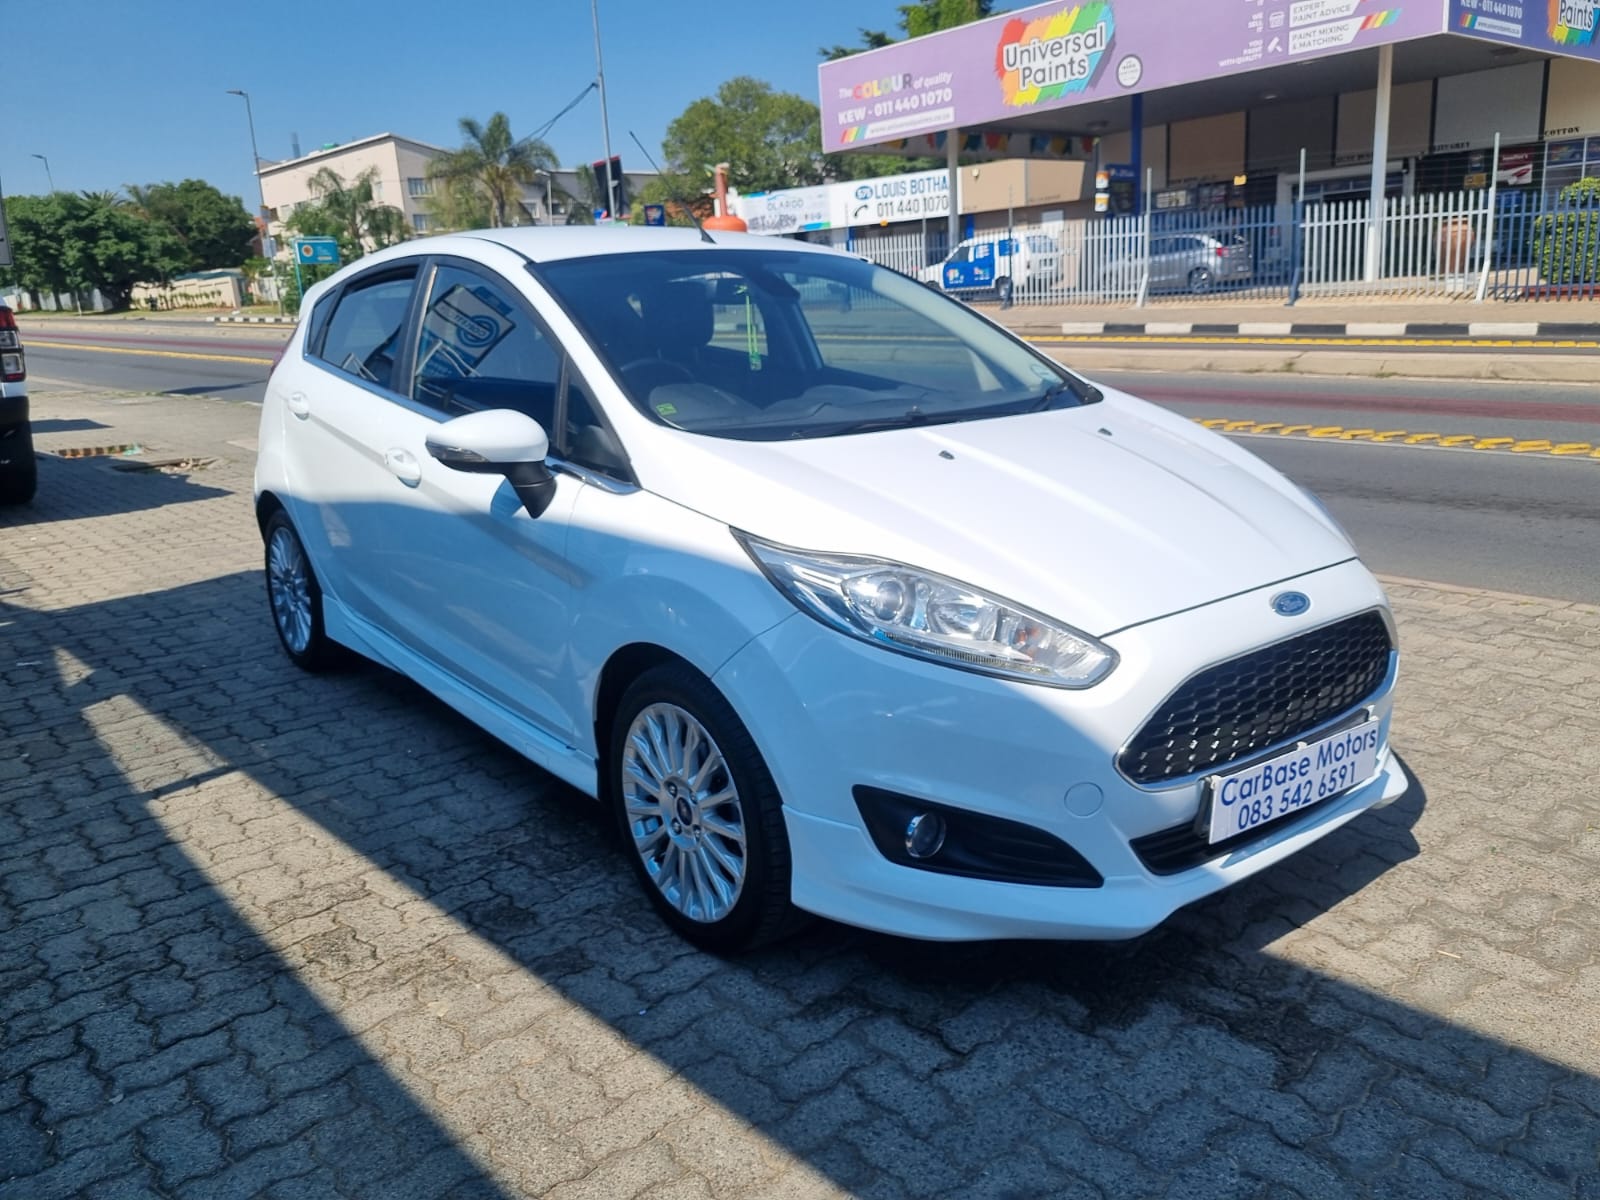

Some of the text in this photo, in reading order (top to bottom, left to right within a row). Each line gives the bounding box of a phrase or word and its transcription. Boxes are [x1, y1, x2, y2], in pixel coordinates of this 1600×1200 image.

[1293, 1, 1325, 13] EXPERT
[1293, 4, 1351, 24] PAINT ADVICE
[1559, 1, 1593, 29] Paints
[1292, 24, 1349, 41] PAINT MIXING
[1299, 34, 1344, 48] MATCHING
[1006, 25, 1104, 67] Universal
[1022, 57, 1087, 87] Paints
[853, 73, 912, 100] COLOUR
[913, 77, 924, 89] of
[924, 71, 953, 89] quality
[838, 107, 866, 125] KEW
[874, 100, 893, 117] 011
[894, 94, 920, 112] 440
[920, 87, 953, 107] 1070
[1544, 126, 1580, 136] COTTON
[874, 180, 907, 199] LOUIS
[910, 175, 948, 194] BOTHA
[877, 195, 949, 217] 011 440 1070
[1221, 729, 1377, 806] CarBase Motors
[1238, 762, 1356, 830] 083 542 6591
